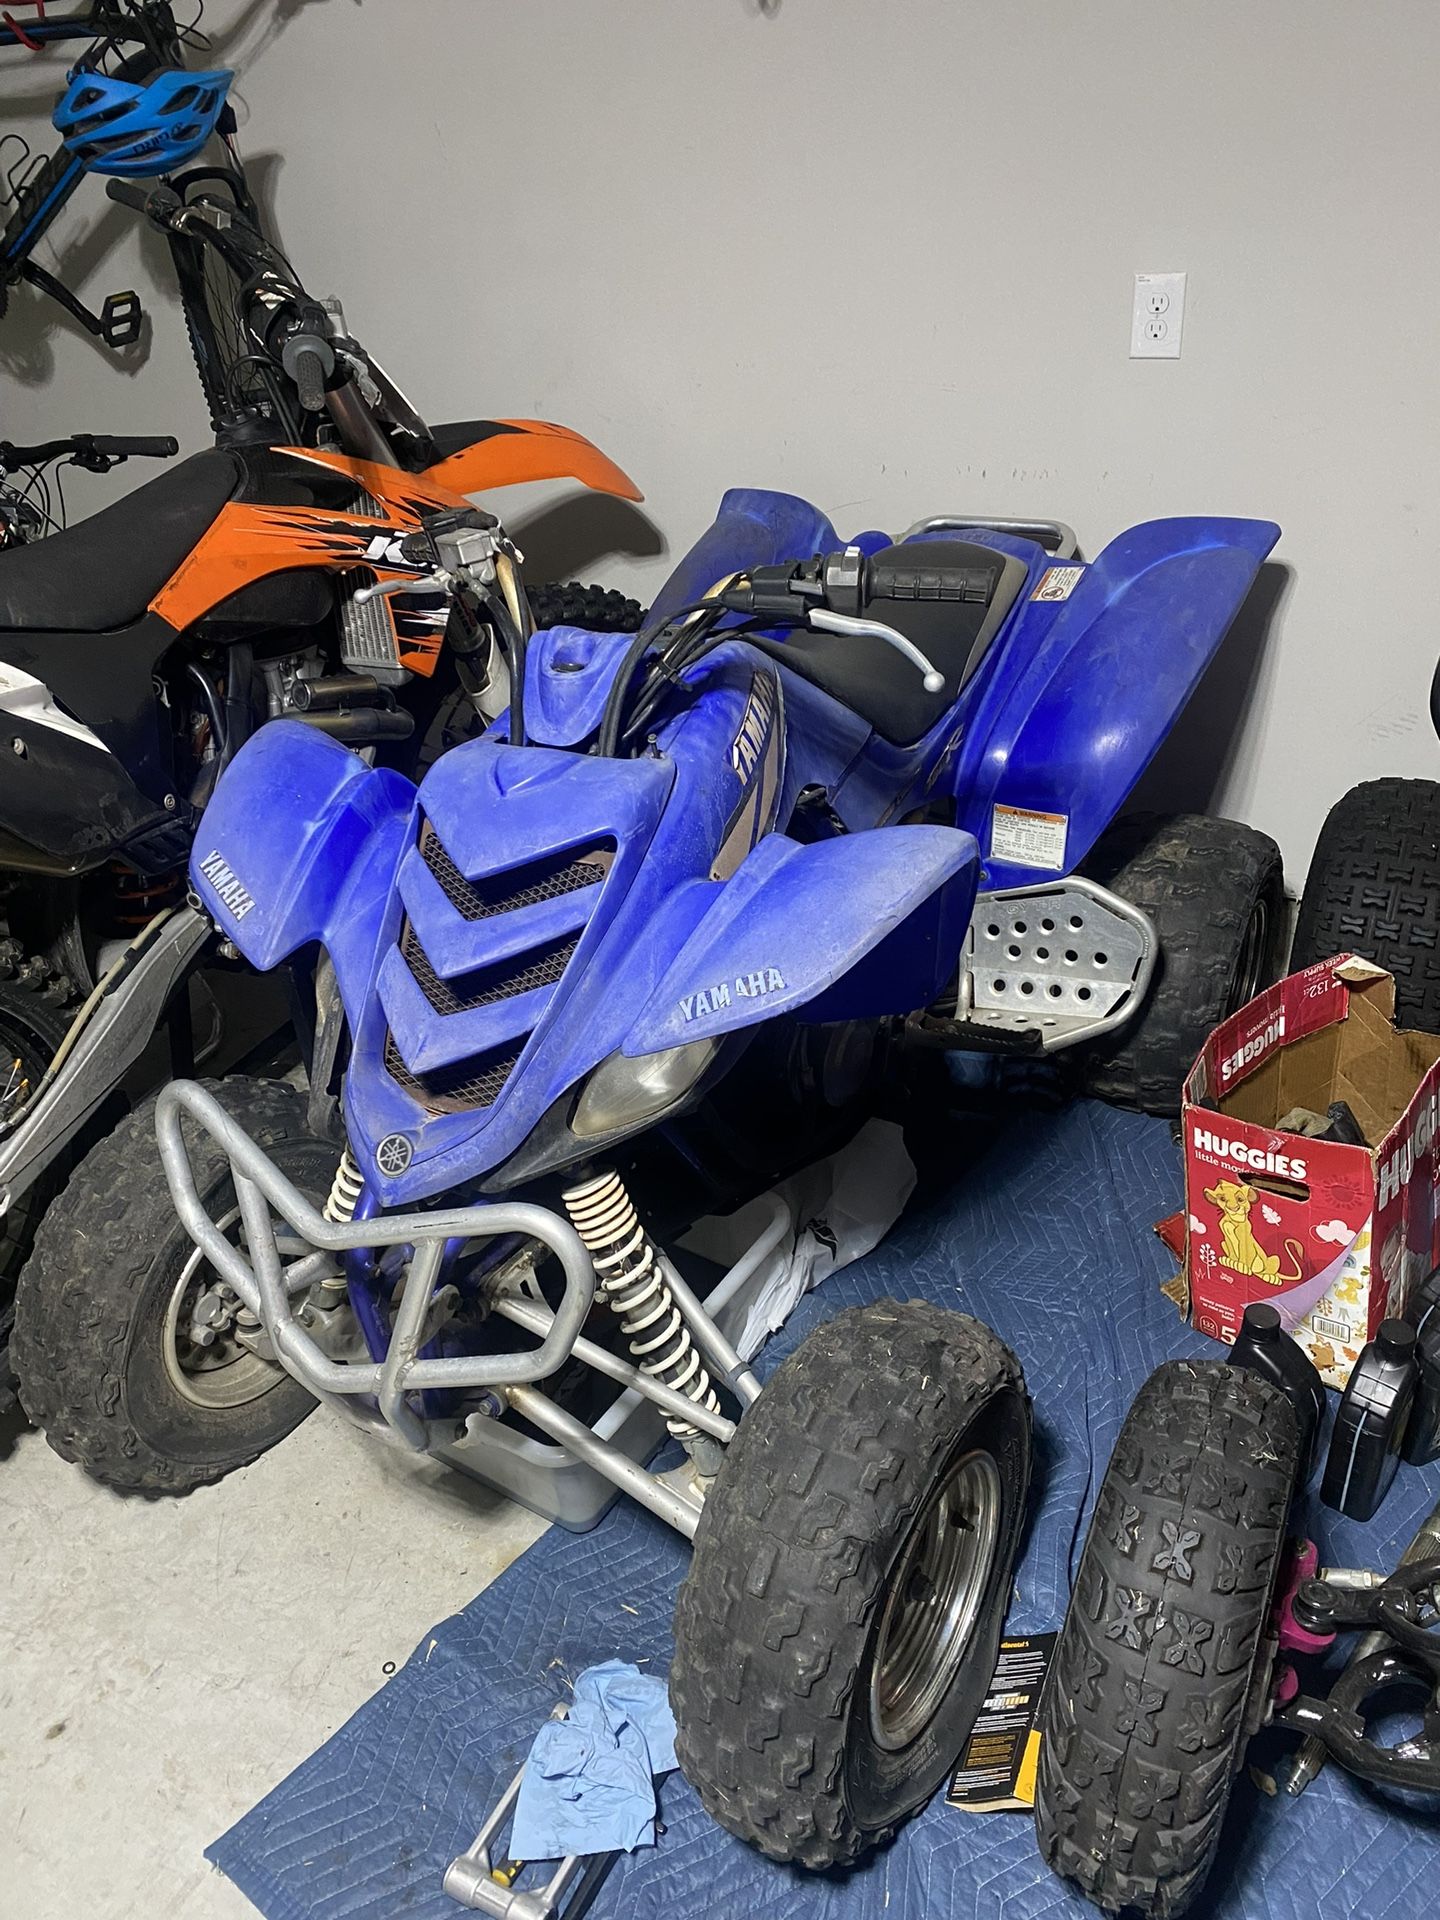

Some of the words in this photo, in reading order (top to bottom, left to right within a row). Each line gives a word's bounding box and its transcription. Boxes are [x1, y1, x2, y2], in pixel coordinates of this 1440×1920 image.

[732, 670, 775, 786] YAMAHA
[199, 848, 256, 922] YAMAHA
[679, 967, 786, 1022] YAMAHA
[1221, 1016, 1286, 1081] HUGGIES
[1193, 1127, 1307, 1180] HUGGIES
[1195, 1149, 1219, 1166] little
[1378, 1087, 1440, 1212] HUGG
[1220, 1325, 1237, 1346] 5
